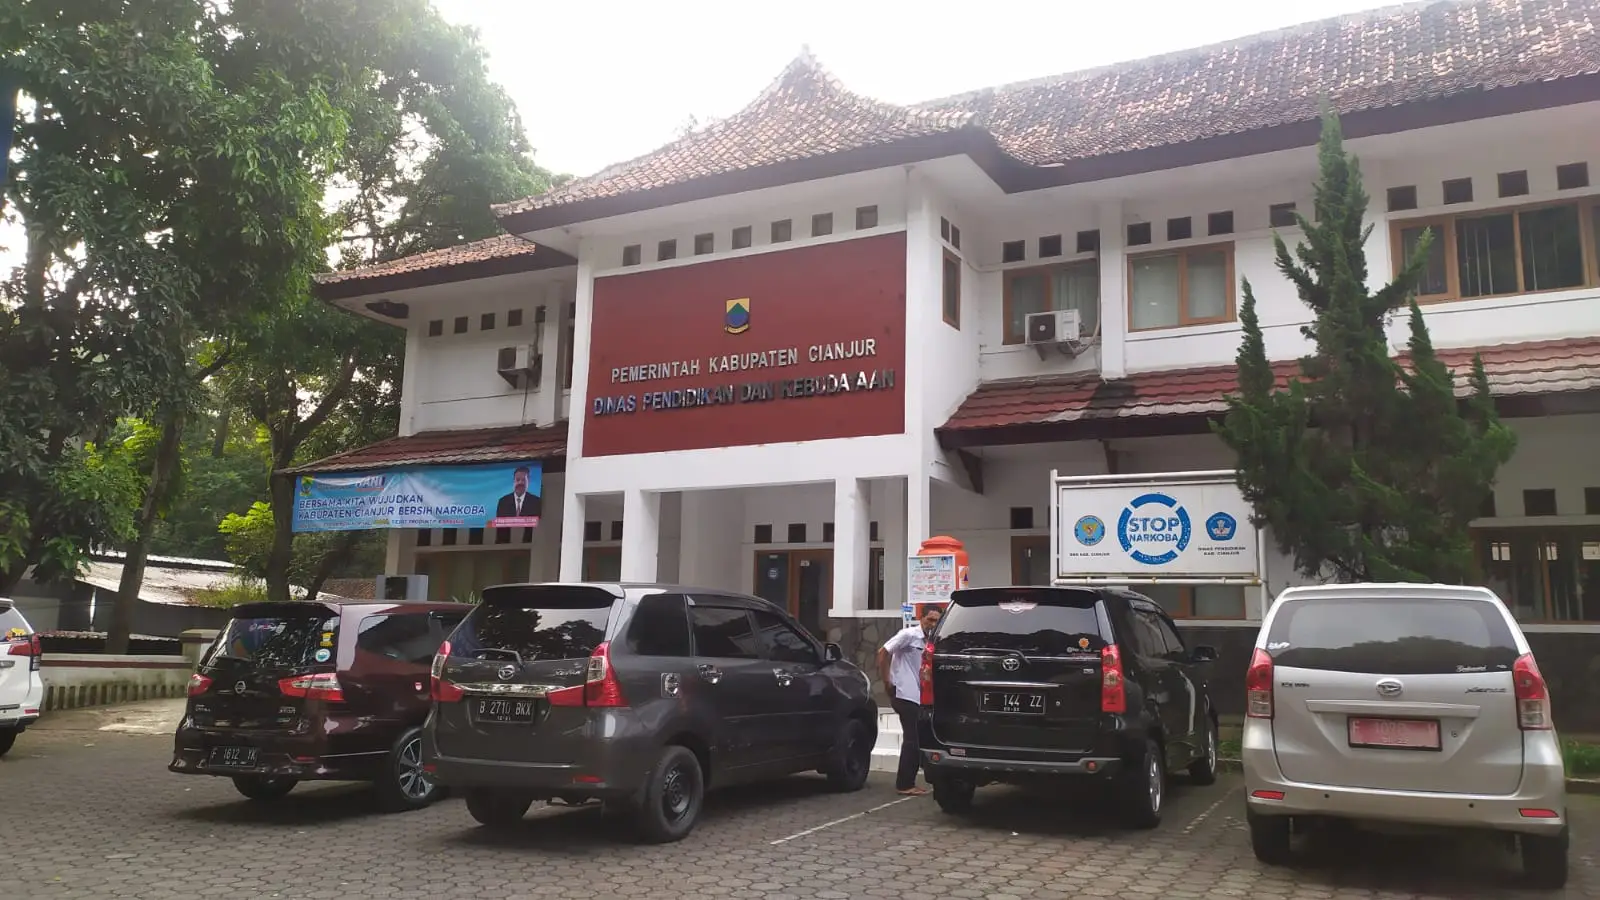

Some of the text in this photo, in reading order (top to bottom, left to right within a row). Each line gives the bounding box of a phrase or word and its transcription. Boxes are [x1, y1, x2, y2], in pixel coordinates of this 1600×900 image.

[611, 338, 876, 384] PEMERINTAH KABUPATEN CIANJUR
[593, 368, 895, 415] DINAS PENDIDIKAN DAN KEBUDAAAN
[299, 494, 424, 509] BERSAMA KITA WUJUDKAN
[298, 505, 486, 520] KABUPATEN CIANJUR BERSIH NARKOBA
[1129, 517, 1180, 532] STOP
[1129, 533, 1179, 542] NARKOBA
[983, 693, 1043, 708] F 144 ZZ
[479, 701, 532, 716] B 2710 BKX
[223, 748, 240, 760] 1612
[247, 748, 257, 761] YK
